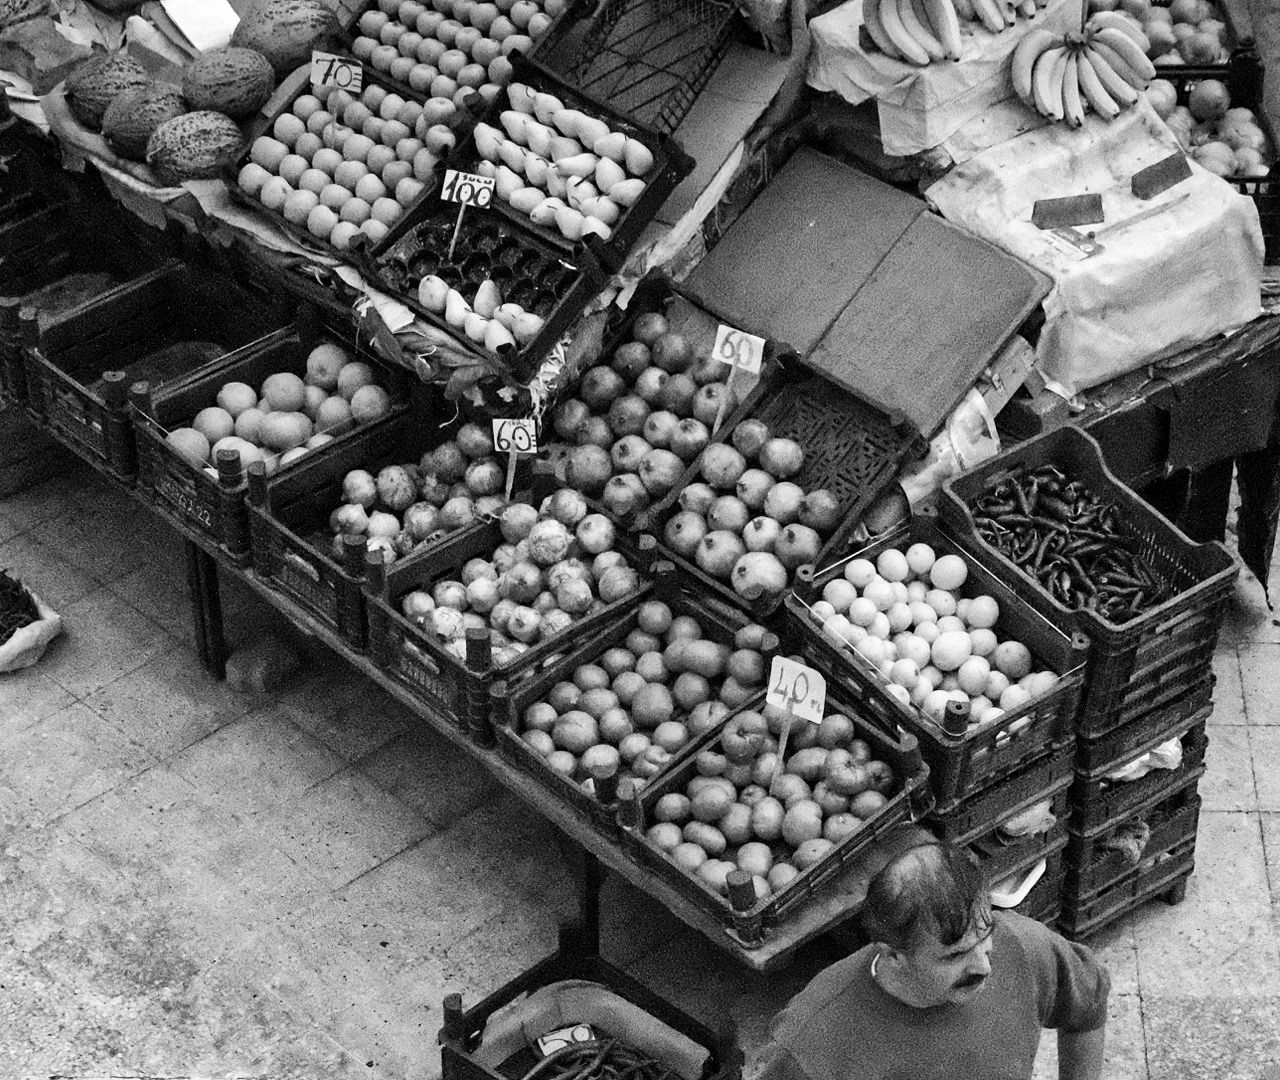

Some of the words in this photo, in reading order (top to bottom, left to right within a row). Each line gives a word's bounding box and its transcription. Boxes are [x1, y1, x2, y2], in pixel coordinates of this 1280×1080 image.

[315, 57, 353, 88] 70
[445, 171, 493, 208] 100
[720, 330, 754, 366] 60
[496, 420, 532, 452] 60
[773, 665, 809, 704] 40
[540, 1024, 594, 1048] 50
